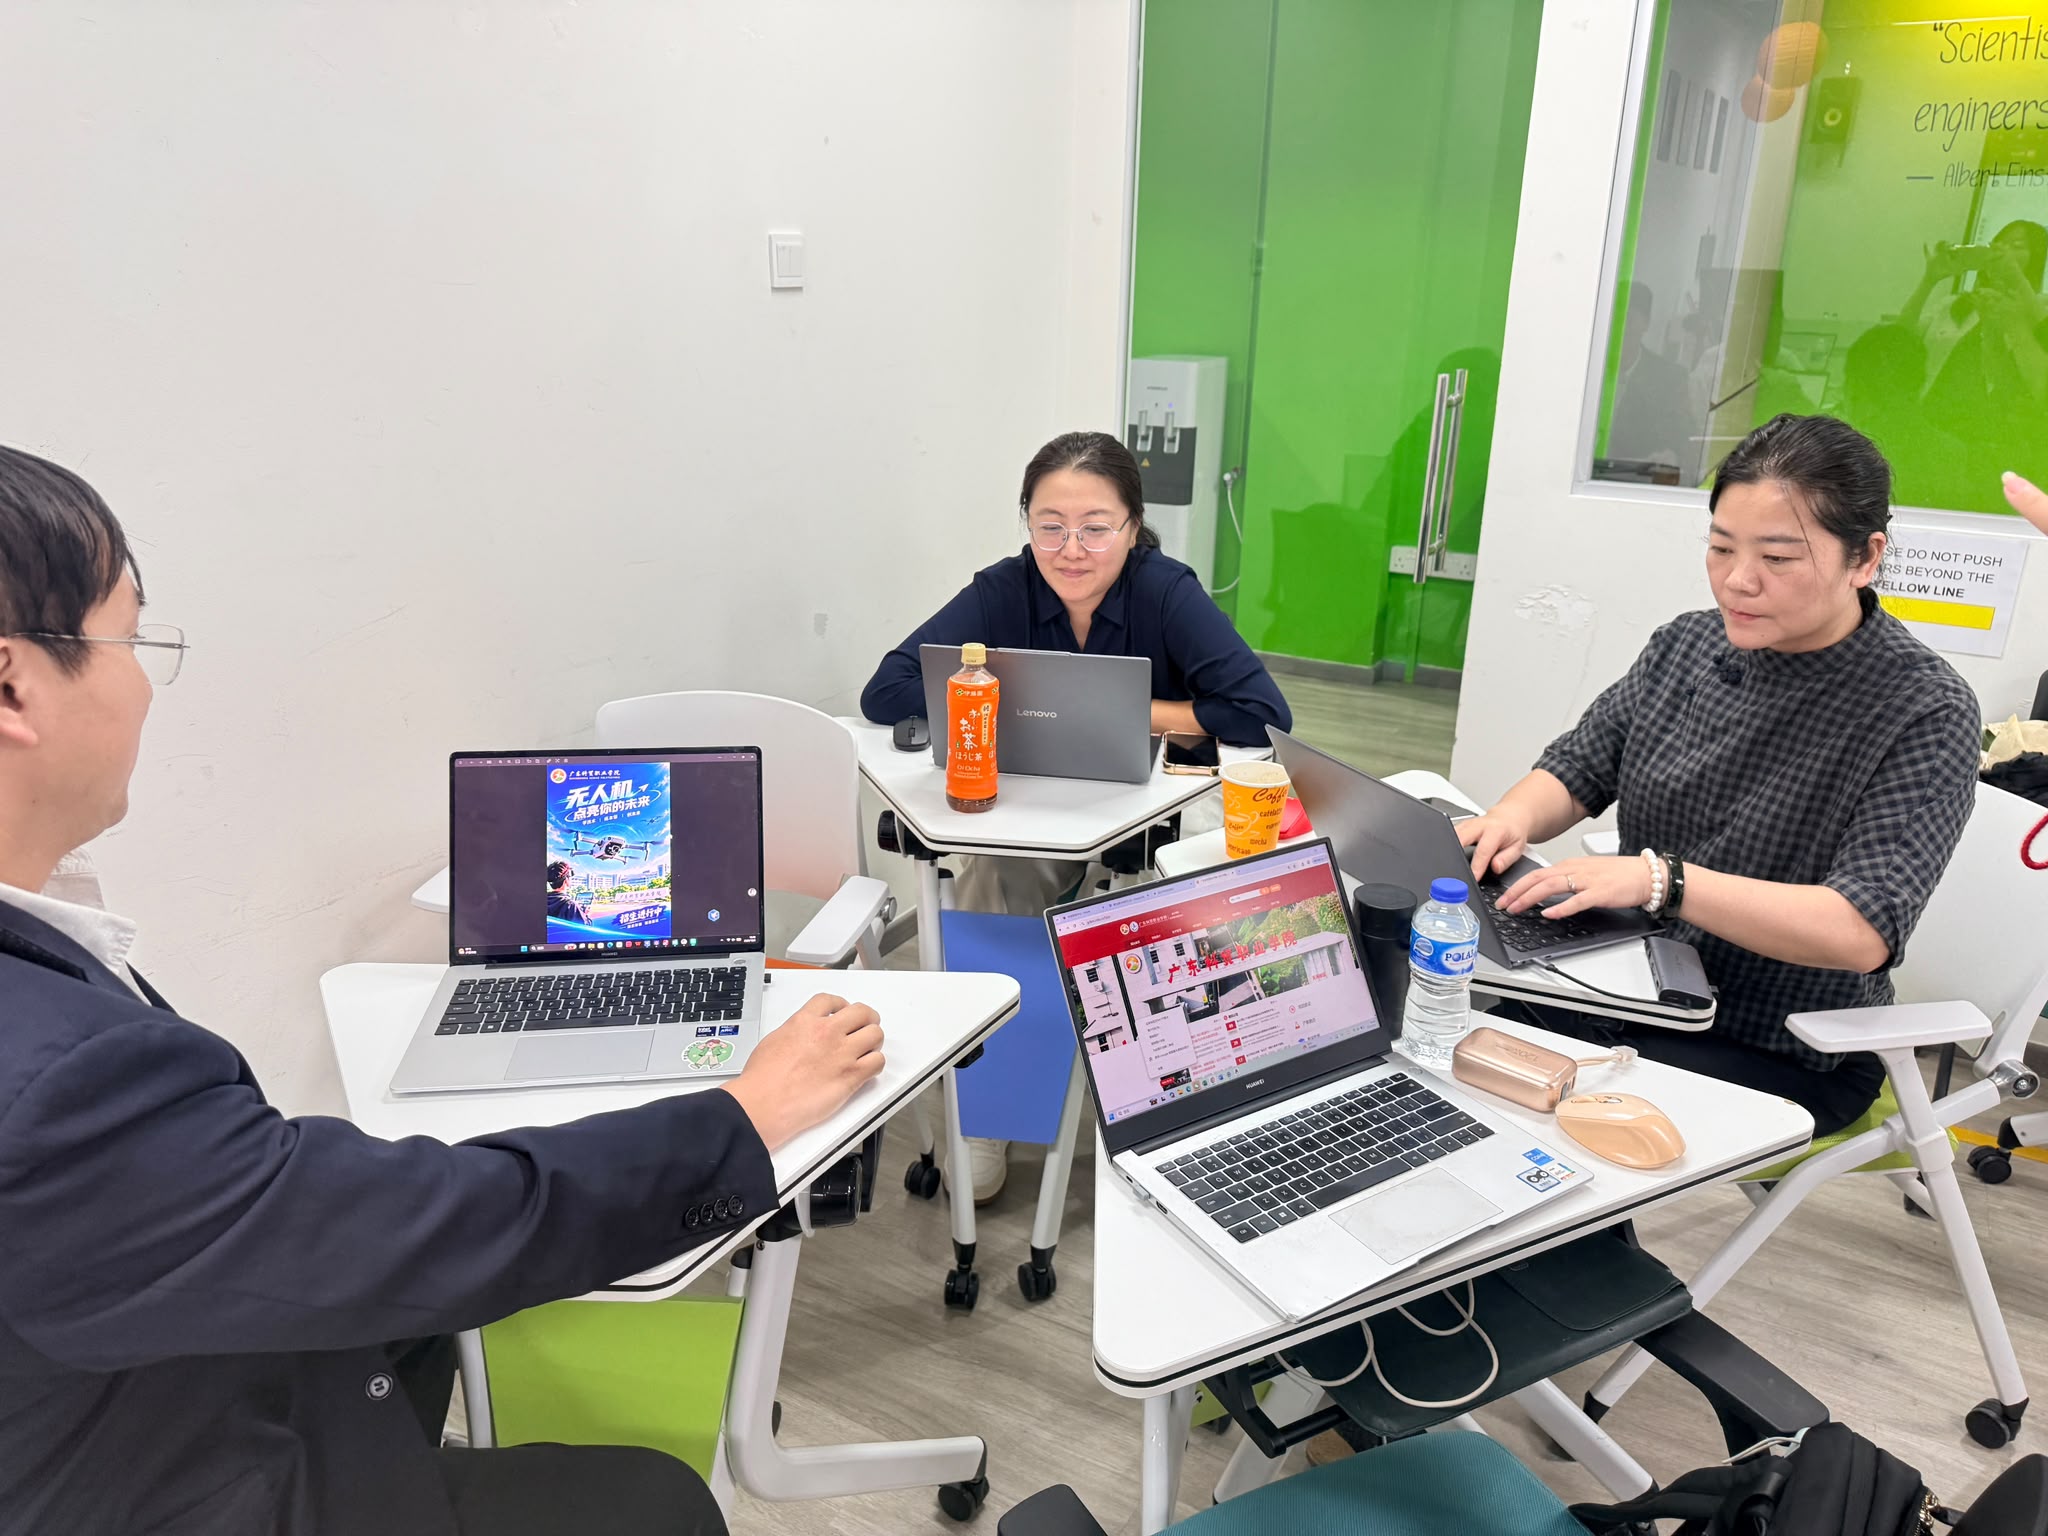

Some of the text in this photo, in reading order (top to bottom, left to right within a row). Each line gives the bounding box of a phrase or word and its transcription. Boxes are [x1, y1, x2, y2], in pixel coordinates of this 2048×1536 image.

[1943, 161, 2000, 188] Albert
[2006, 161, 2048, 188] Eins
[1906, 548, 1928, 560] DO
[1930, 550, 1961, 563] NOT
[1963, 553, 2003, 567] PUSH
[1905, 565, 1963, 581] BEYOND
[1967, 571, 1995, 584] THE
[1933, 585, 1965, 598] LINE
[1016, 708, 1057, 718] Lenovo
[956, 751, 983, 762] ほうじ茶
[565, 779, 633, 810] 无人机
[573, 795, 650, 820] 点亮你的未来
